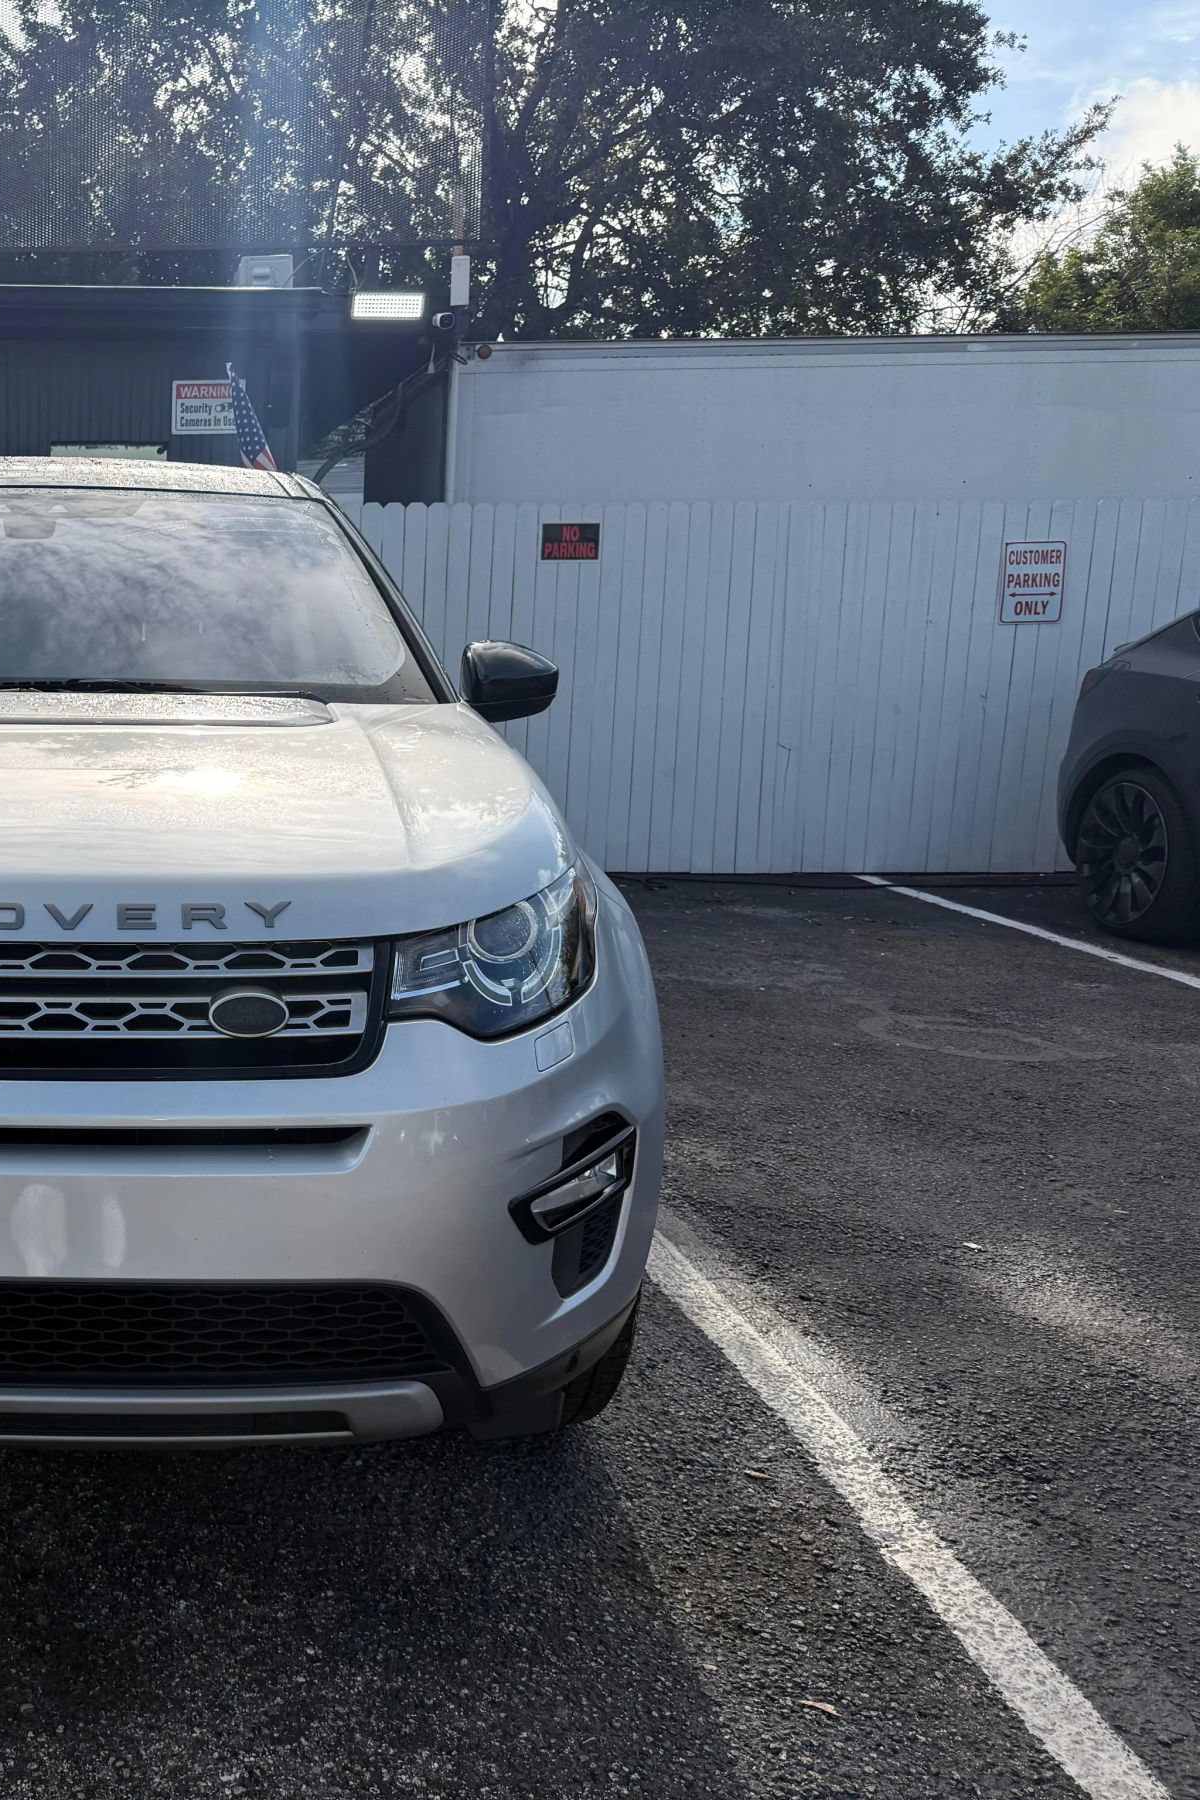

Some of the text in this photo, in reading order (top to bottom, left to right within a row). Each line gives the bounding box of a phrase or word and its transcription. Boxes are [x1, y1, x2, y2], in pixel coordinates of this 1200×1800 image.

[180, 386, 232, 398] WARNIN
[180, 402, 212, 415] Security
[180, 416, 211, 427] Cameras
[214, 416, 221, 427] In
[562, 526, 580, 541] NO
[544, 542, 596, 558] PARKING
[1008, 549, 1062, 565] CUSTOMER
[1007, 572, 1060, 588] PARKING
[1014, 600, 1049, 616] ONLY
